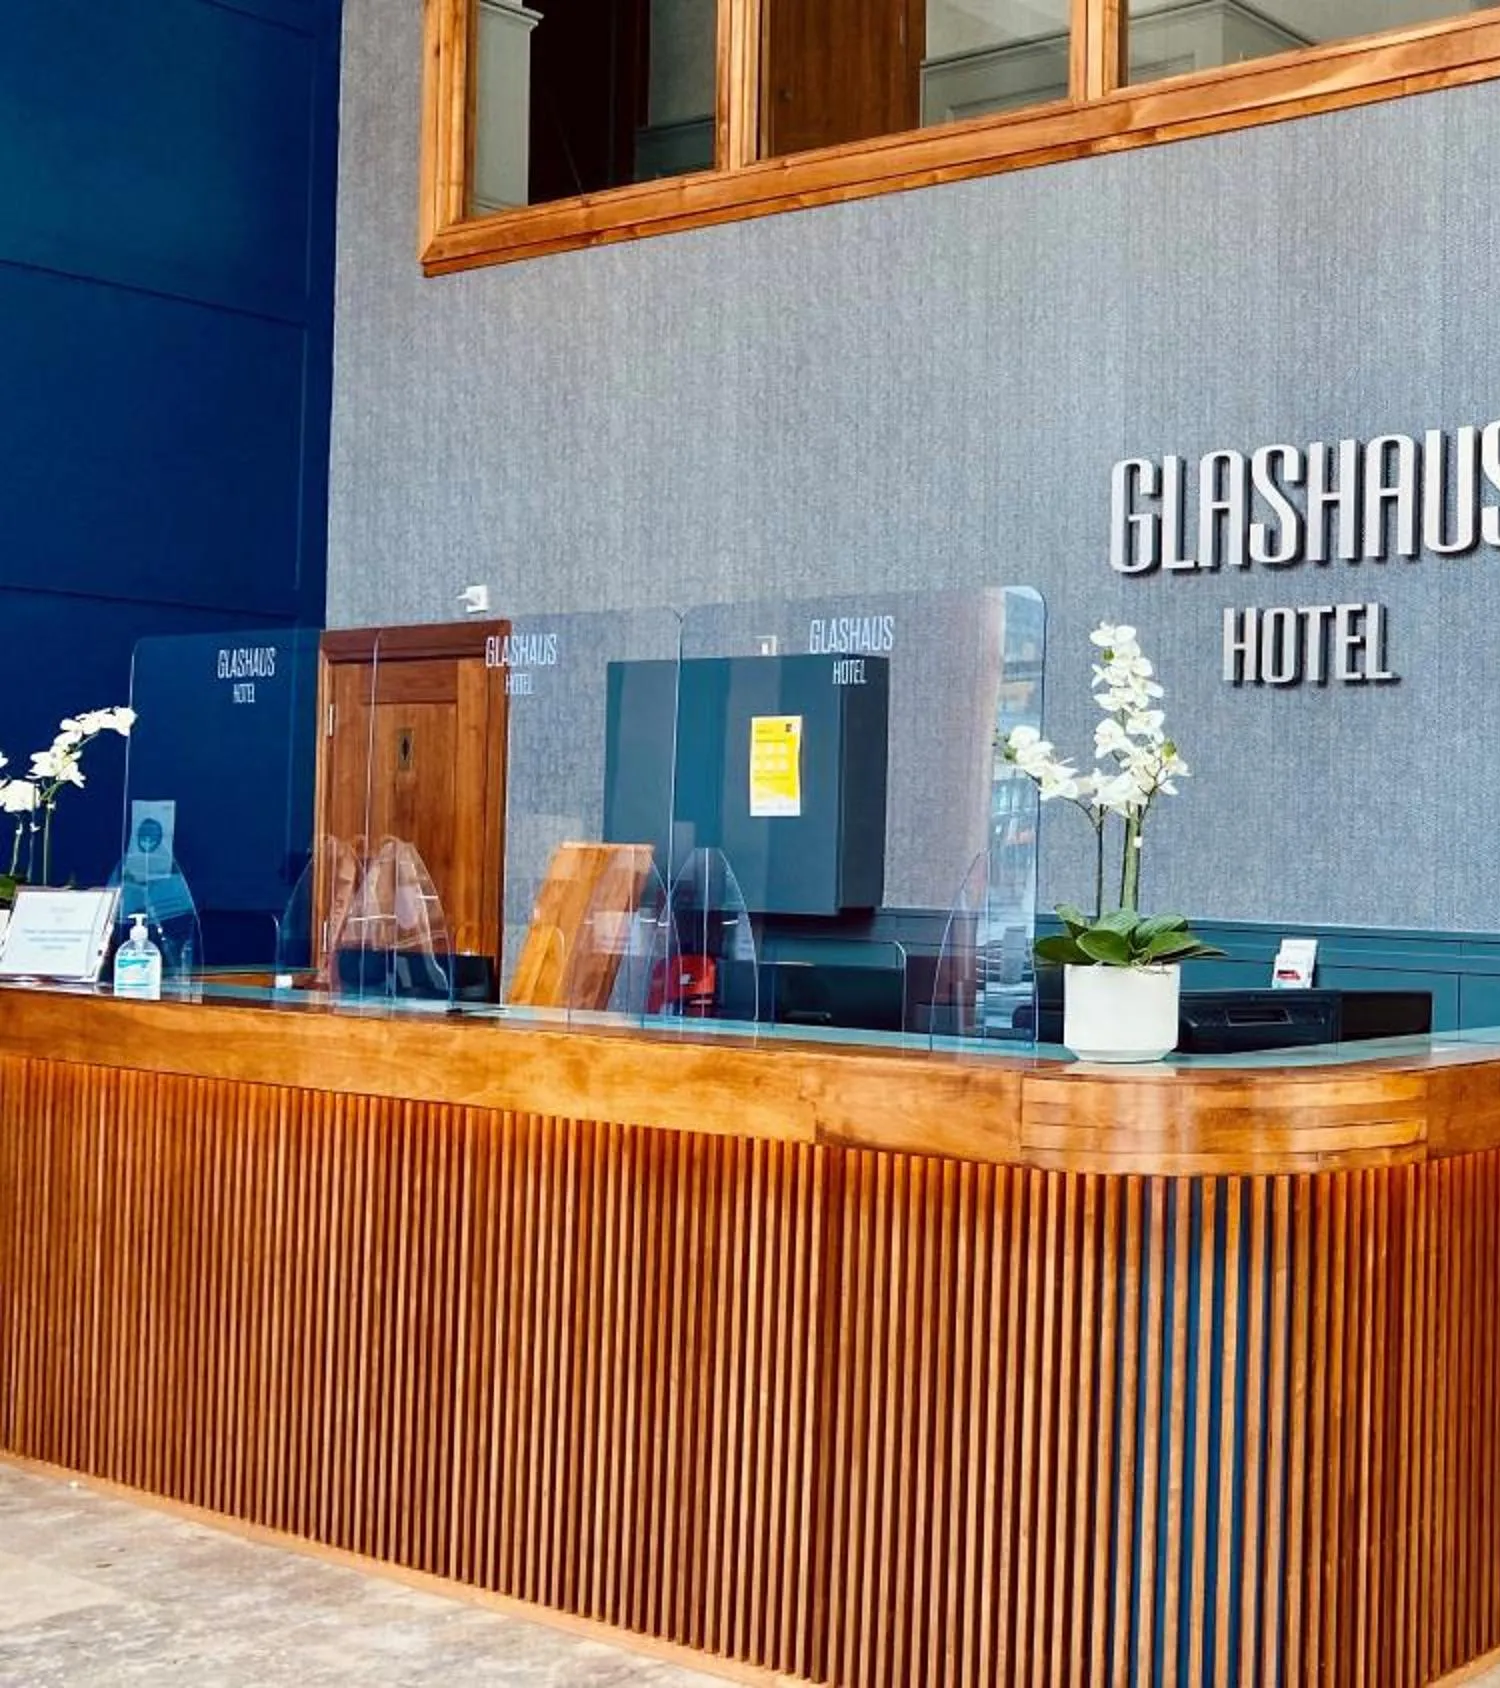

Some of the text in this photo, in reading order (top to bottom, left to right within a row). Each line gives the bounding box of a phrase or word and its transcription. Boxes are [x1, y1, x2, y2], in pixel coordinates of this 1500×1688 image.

[485, 633, 558, 668] GLASHAUS
[809, 615, 894, 655] GLASHAUS
[1223, 602, 1399, 685] HOTEL
[217, 646, 276, 679] GLASHAUS
[832, 659, 867, 685] HOTEL
